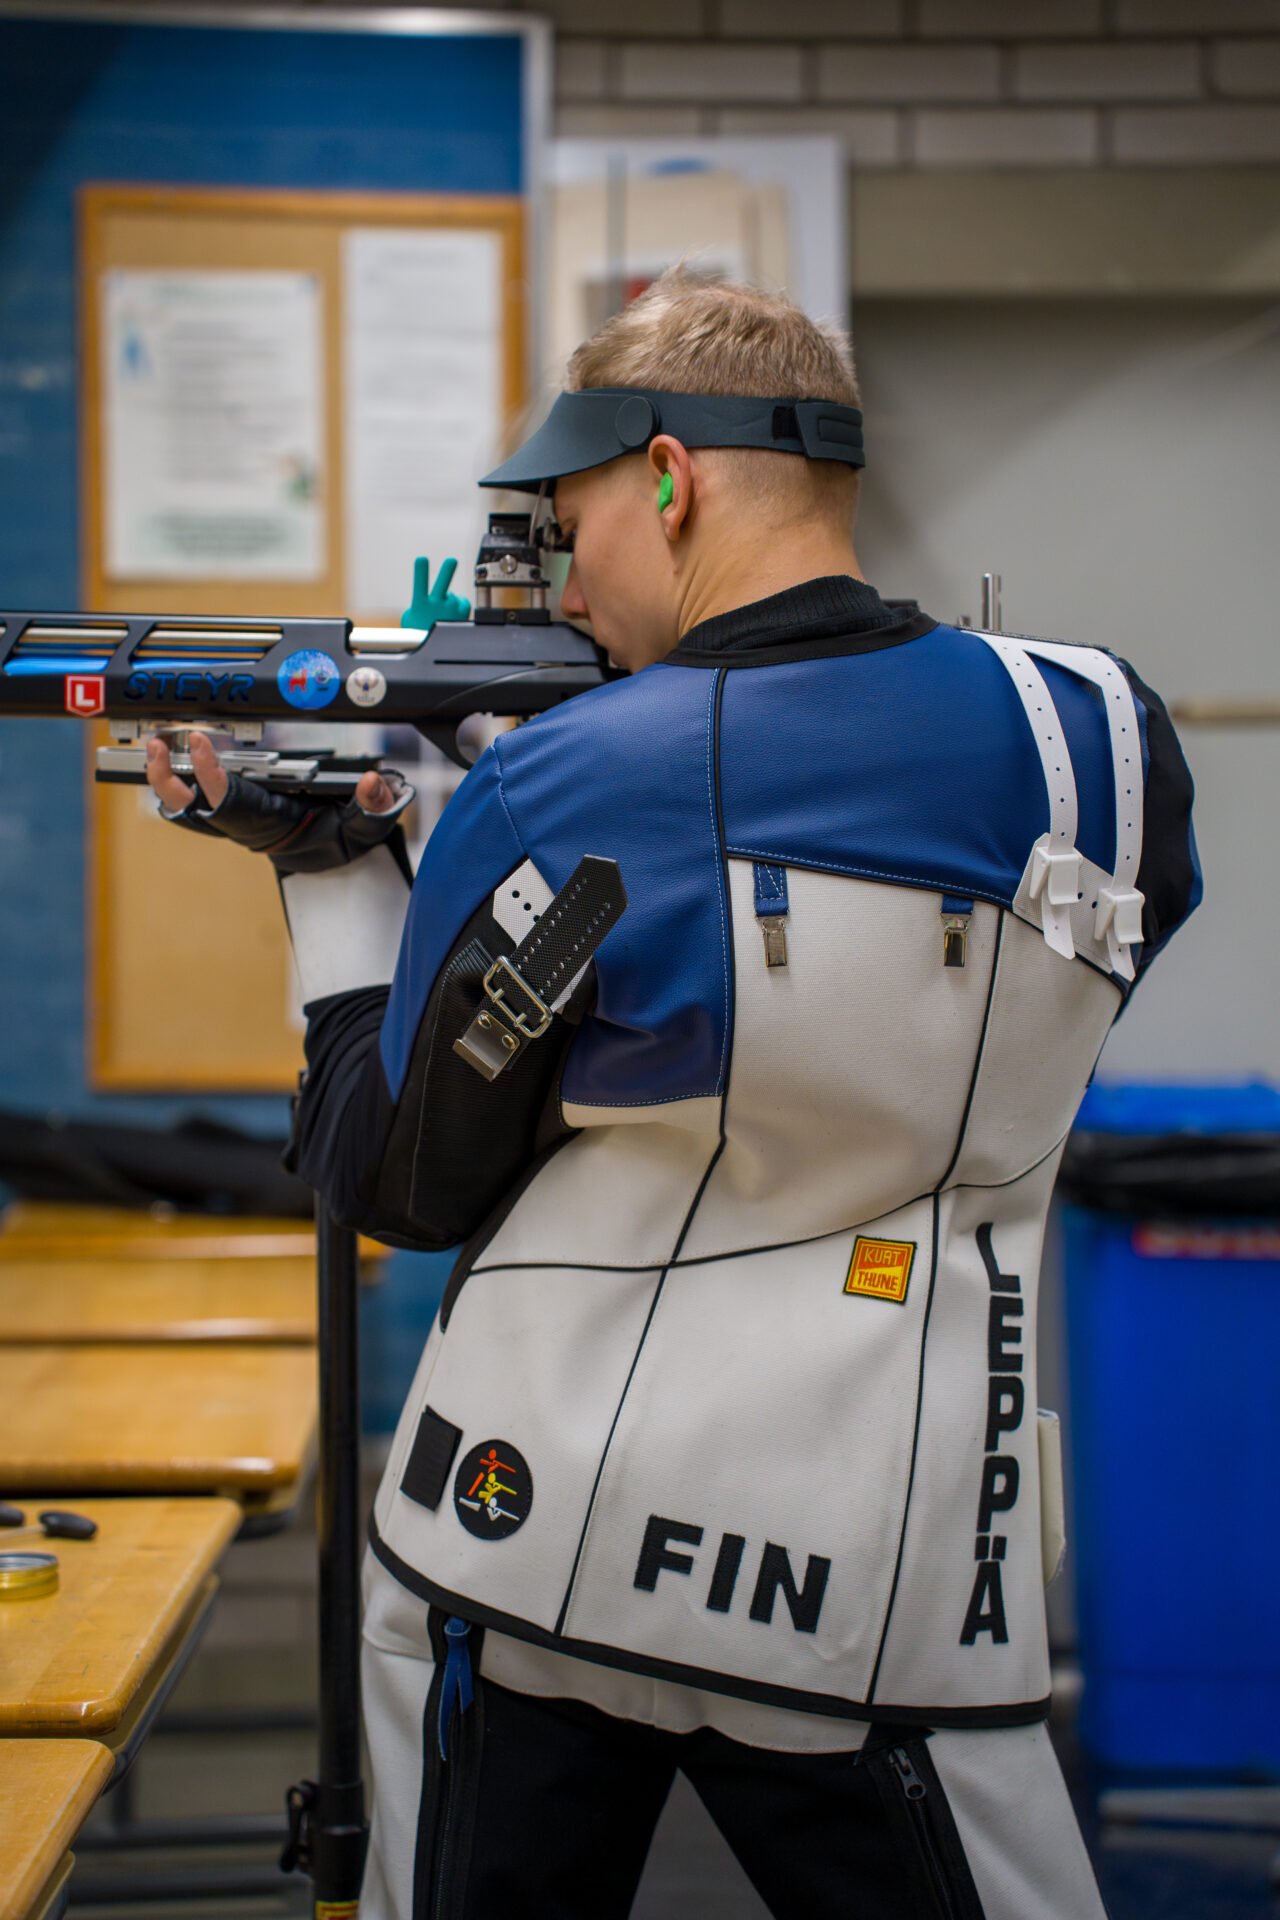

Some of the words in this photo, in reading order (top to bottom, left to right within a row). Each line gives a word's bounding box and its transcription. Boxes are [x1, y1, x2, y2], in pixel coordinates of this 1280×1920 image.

[75, 684, 96, 707] L
[124, 671, 256, 702] STEYR
[857, 1271, 899, 1292] THUNE
[959, 1222, 1025, 1646] LEPPÄ
[633, 1514, 832, 1634] FIN
